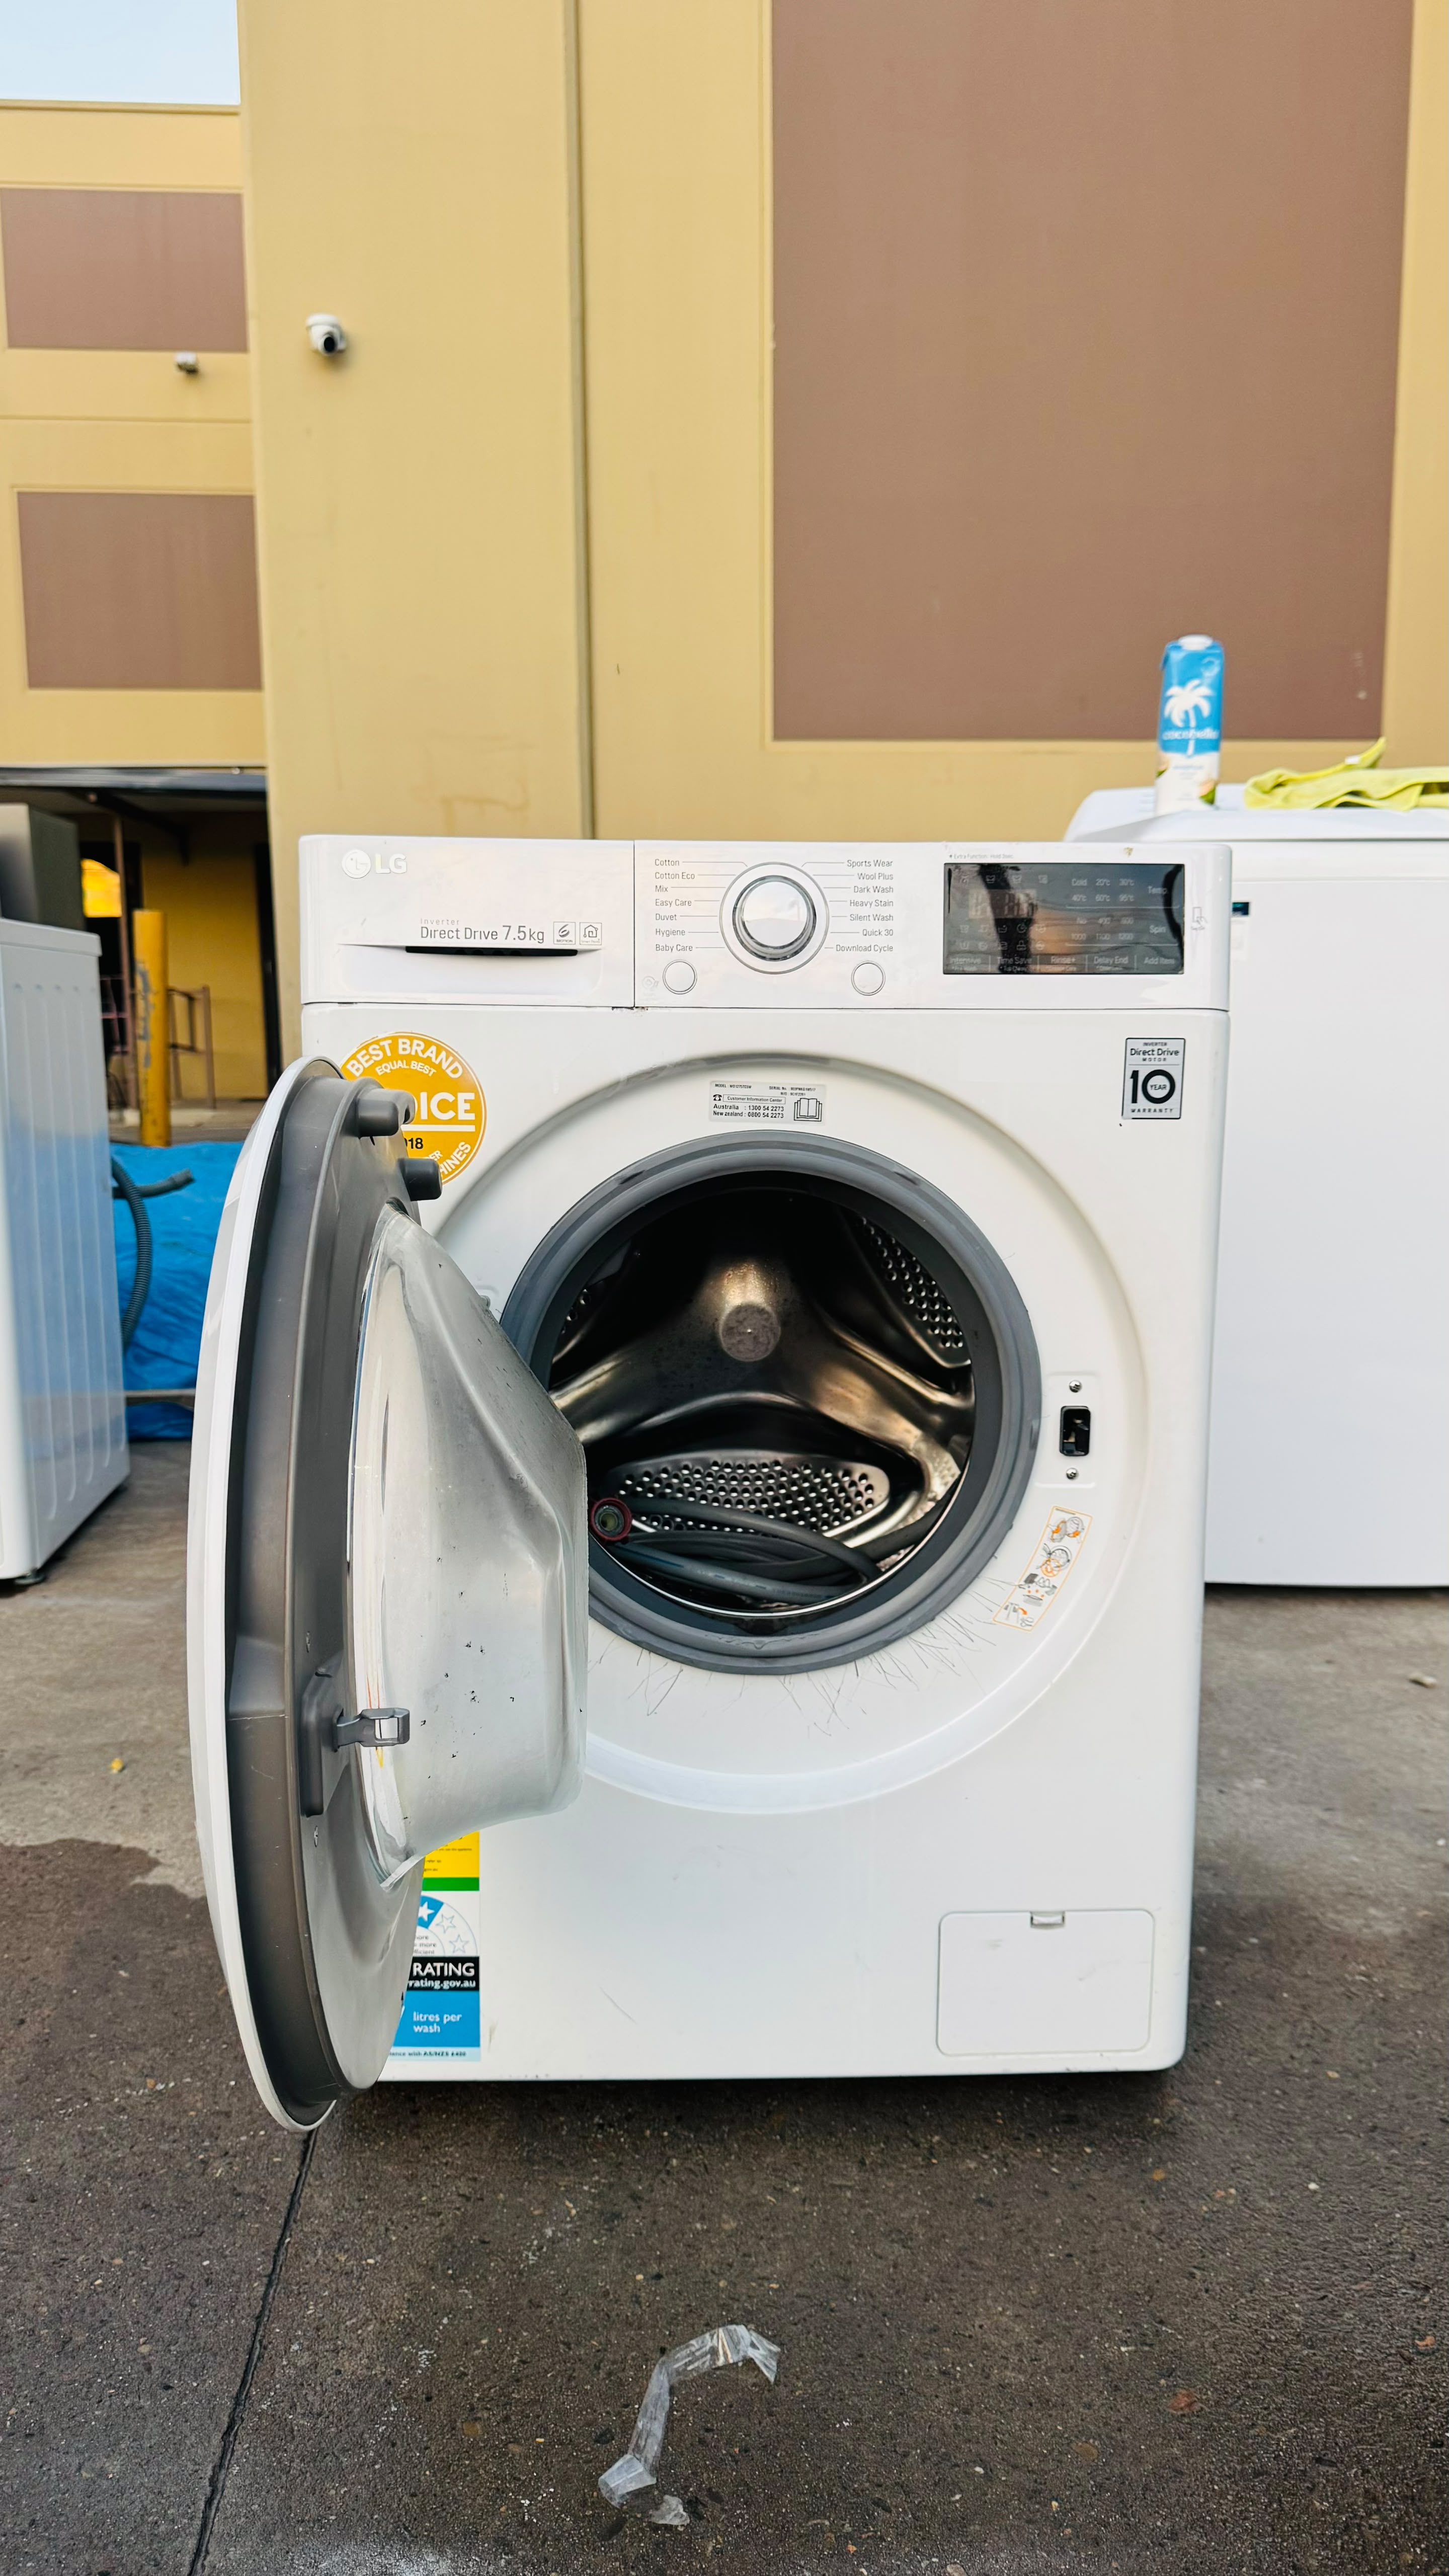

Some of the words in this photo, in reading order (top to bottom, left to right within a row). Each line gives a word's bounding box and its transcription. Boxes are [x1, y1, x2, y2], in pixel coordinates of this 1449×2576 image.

[375, 853, 407, 874] LG
[847, 859, 871, 868] Sports
[655, 899, 673, 908] Easy
[850, 900, 873, 908] Heavy
[421, 927, 460, 940] Direct
[465, 927, 498, 940] Drive
[656, 928, 685, 937] Hygiene
[1149, 925, 1166, 934] Spin
[656, 944, 674, 952] Baby
[873, 944, 893, 953] Cycle
[346, 1039, 392, 1077] BEST
[398, 1038, 463, 1078] BRAND
[375, 1060, 409, 1076] EQUAL
[411, 1061, 437, 1076] BEST
[1130, 1069, 1176, 1104] 10
[413, 1962, 475, 1977] RATING
[413, 2011, 440, 2022] litres
[443, 2014, 462, 2024] per
[413, 2023, 441, 2033] wash
